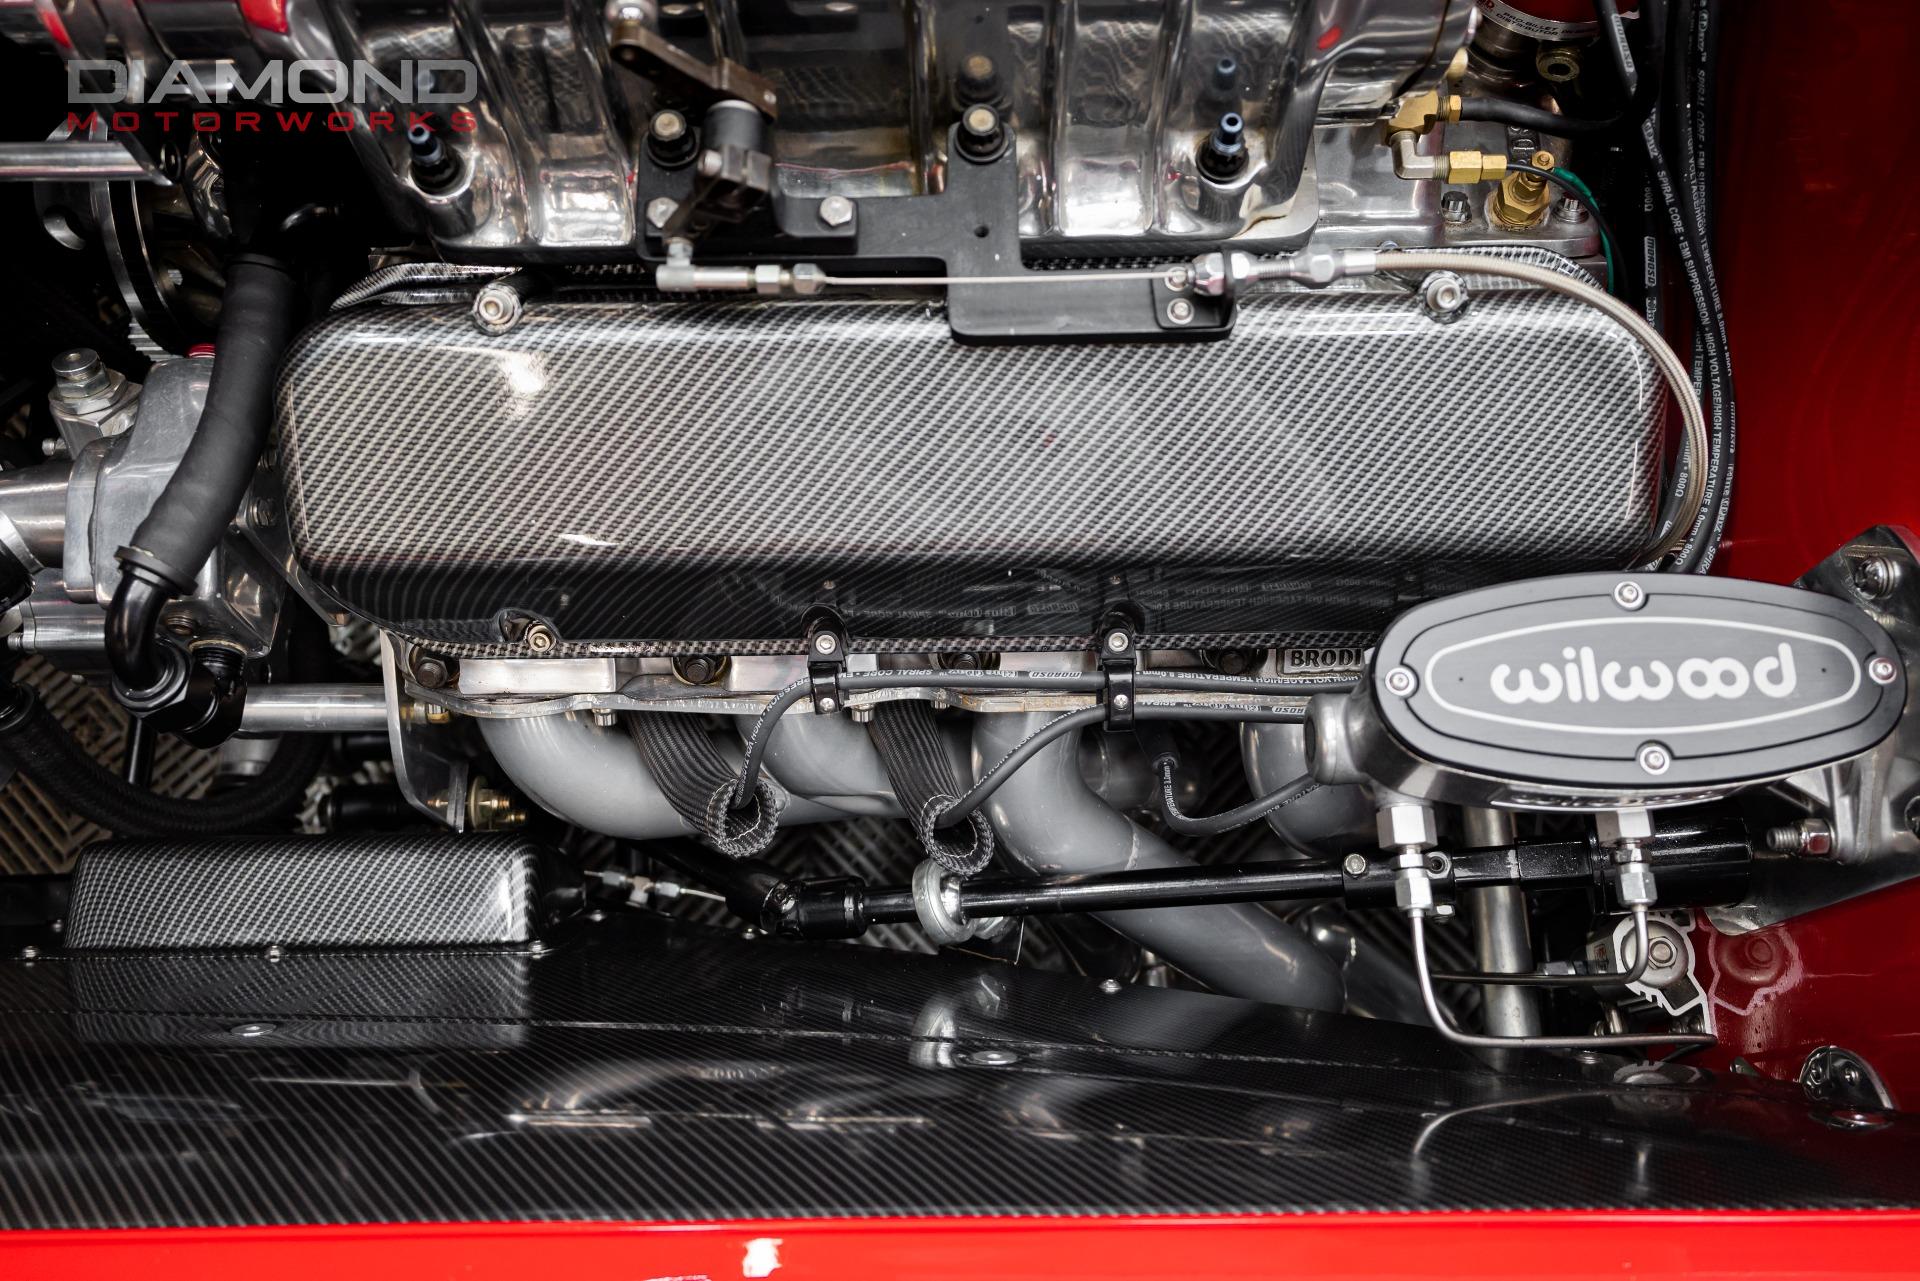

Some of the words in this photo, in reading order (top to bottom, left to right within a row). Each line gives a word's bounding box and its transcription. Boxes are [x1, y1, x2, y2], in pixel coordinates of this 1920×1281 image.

[1696, 110, 1705, 142] CORE
[1697, 150, 1706, 169] EMI
[1657, 170, 1675, 206] SPIRAL
[1668, 206, 1685, 234] CORE
[1645, 236, 1656, 287] MOROSO
[1679, 240, 1693, 260] EMI
[1701, 235, 1722, 313] TEMPERATURE
[1684, 259, 1712, 326] SUPPRESSION
[1704, 332, 1718, 357] HIGH
[1702, 432, 1722, 506] TEMPERATURE
[1699, 545, 1717, 575] SPIRA
[1291, 649, 1361, 668] BRODI
[1029, 671, 1082, 680] MOROSO
[1177, 671, 1254, 683] TEMPERATURE
[1490, 642, 1797, 705] wilwood
[1271, 706, 1306, 715] ROSO
[749, 717, 764, 741] HIGH
